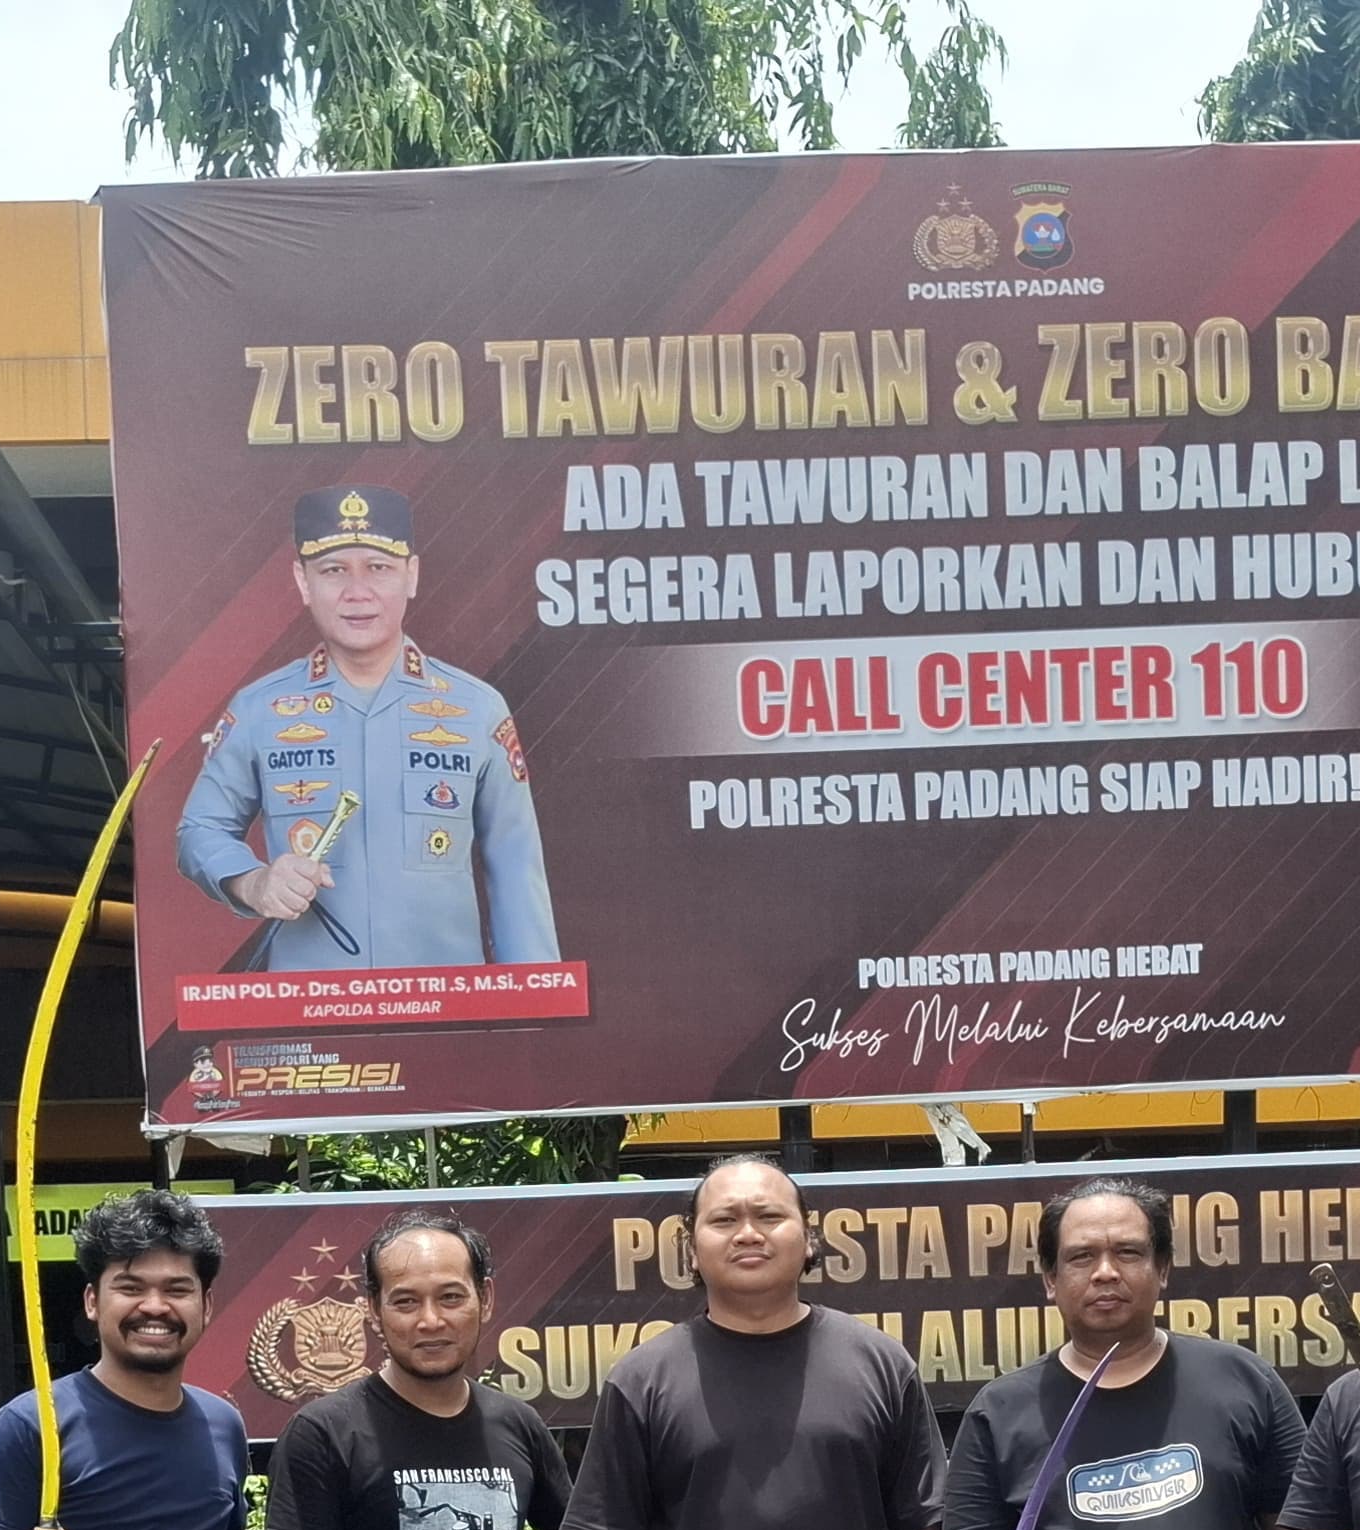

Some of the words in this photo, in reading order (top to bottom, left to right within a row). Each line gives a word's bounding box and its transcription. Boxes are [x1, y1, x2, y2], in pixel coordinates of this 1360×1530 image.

[908, 280, 1012, 300] POLRESTA
[1014, 278, 1105, 297] PADANG
[244, 341, 464, 445] ZERO
[484, 328, 929, 437] TAWURAN
[955, 341, 1017, 425] &
[1037, 316, 1250, 423] ZERO
[563, 463, 685, 533] ADA
[694, 452, 987, 528] TAWURAN
[1004, 446, 1124, 517] DAN
[1138, 440, 1324, 511] BALAP
[536, 552, 762, 627] SEGERA
[775, 543, 1082, 617] LAPORKAN
[1099, 535, 1216, 604] DAN
[735, 654, 902, 740] CALL
[916, 640, 1175, 732] CENTER
[1191, 636, 1307, 720] 110
[268, 750, 313, 769] GATOT
[317, 749, 335, 767] TS
[409, 752, 471, 773] POLRI
[689, 772, 904, 829] POLRESTA
[910, 765, 1089, 823] PADANG
[1101, 760, 1202, 814] SIAP
[858, 954, 994, 989] POLRESTA
[1000, 948, 1110, 984] PADANG
[1116, 943, 1204, 978] HEBAT
[183, 984, 236, 1002] IRJEN
[240, 982, 274, 1000] POL
[279, 981, 305, 999] Dr.
[309, 979, 345, 997] Drs.
[349, 977, 414, 996] GATOT
[416, 976, 446, 994] TRI
[527, 971, 577, 989] CSFA
[303, 1002, 373, 1018] KAPOLDA
[378, 1000, 442, 1016] SUMBAR
[780, 998, 889, 1072] Sukses
[904, 993, 1049, 1065] Melalui
[1063, 986, 1286, 1059] Kebersamaan
[279, 1055, 310, 1066] POLRI
[312, 1053, 340, 1064] YANG
[236, 1063, 401, 1092] PRESISI
[393, 1469, 419, 1484] SAN
[1087, 1478, 1188, 1512] QUIKSILVER
